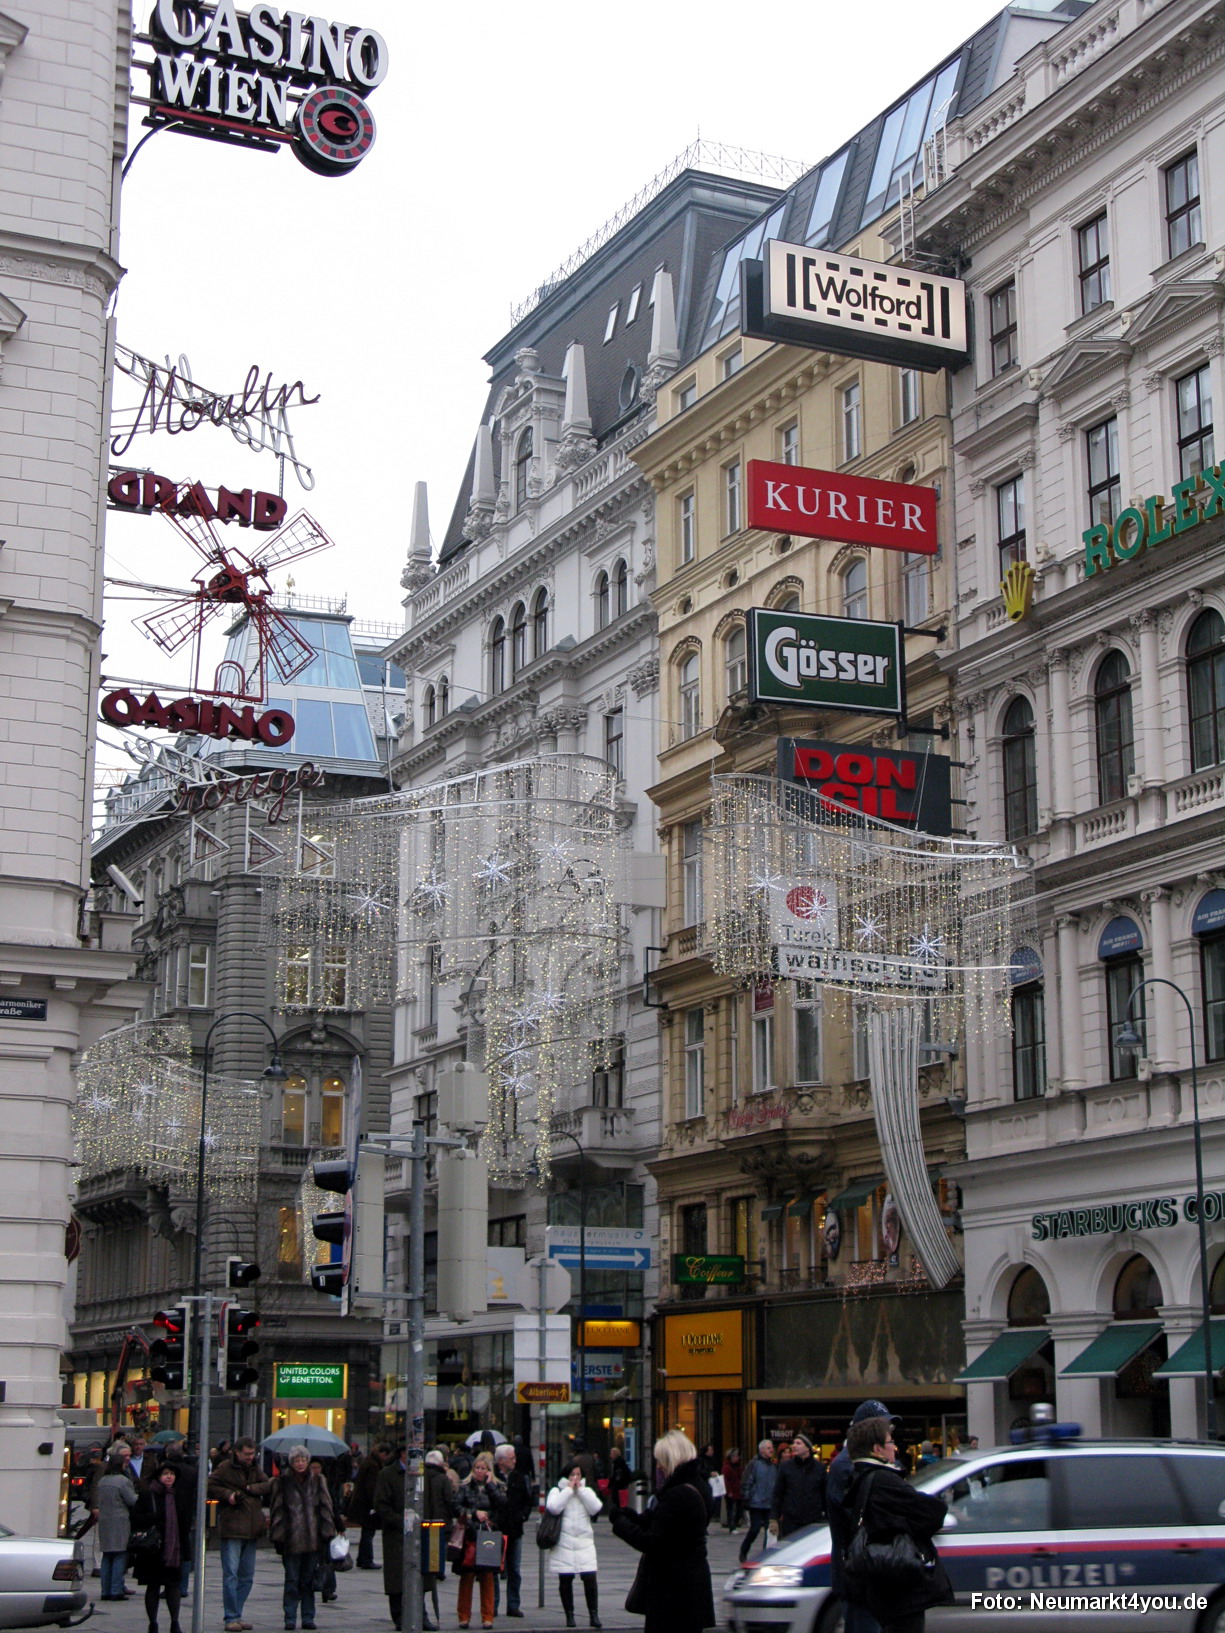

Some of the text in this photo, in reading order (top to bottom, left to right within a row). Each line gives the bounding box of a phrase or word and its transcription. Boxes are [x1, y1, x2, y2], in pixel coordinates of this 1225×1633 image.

[158, 0, 389, 87] CASINO
[157, 54, 291, 127] WIEN
[815, 273, 923, 321] Wolford
[111, 365, 321, 456] Moulin
[107, 472, 288, 531] GRAND
[764, 479, 927, 533] KURIER
[1082, 459, 1225, 578] ROLEX
[764, 626, 890, 688] Gösser
[101, 689, 296, 747] CASINO
[793, 747, 917, 790] DON
[170, 761, 326, 825] rouge
[818, 782, 917, 822] GIL
[782, 924, 833, 945] Turek
[1031, 1198, 1178, 1241] STARBUCKS
[686, 1256, 734, 1282] Coiffeur
[280, 1367, 308, 1375] UNITED
[583, 1365, 612, 1375] ERSTE
[770, 1430, 793, 1438] TISSOT
[985, 1563, 1117, 1589] POLIZEI
